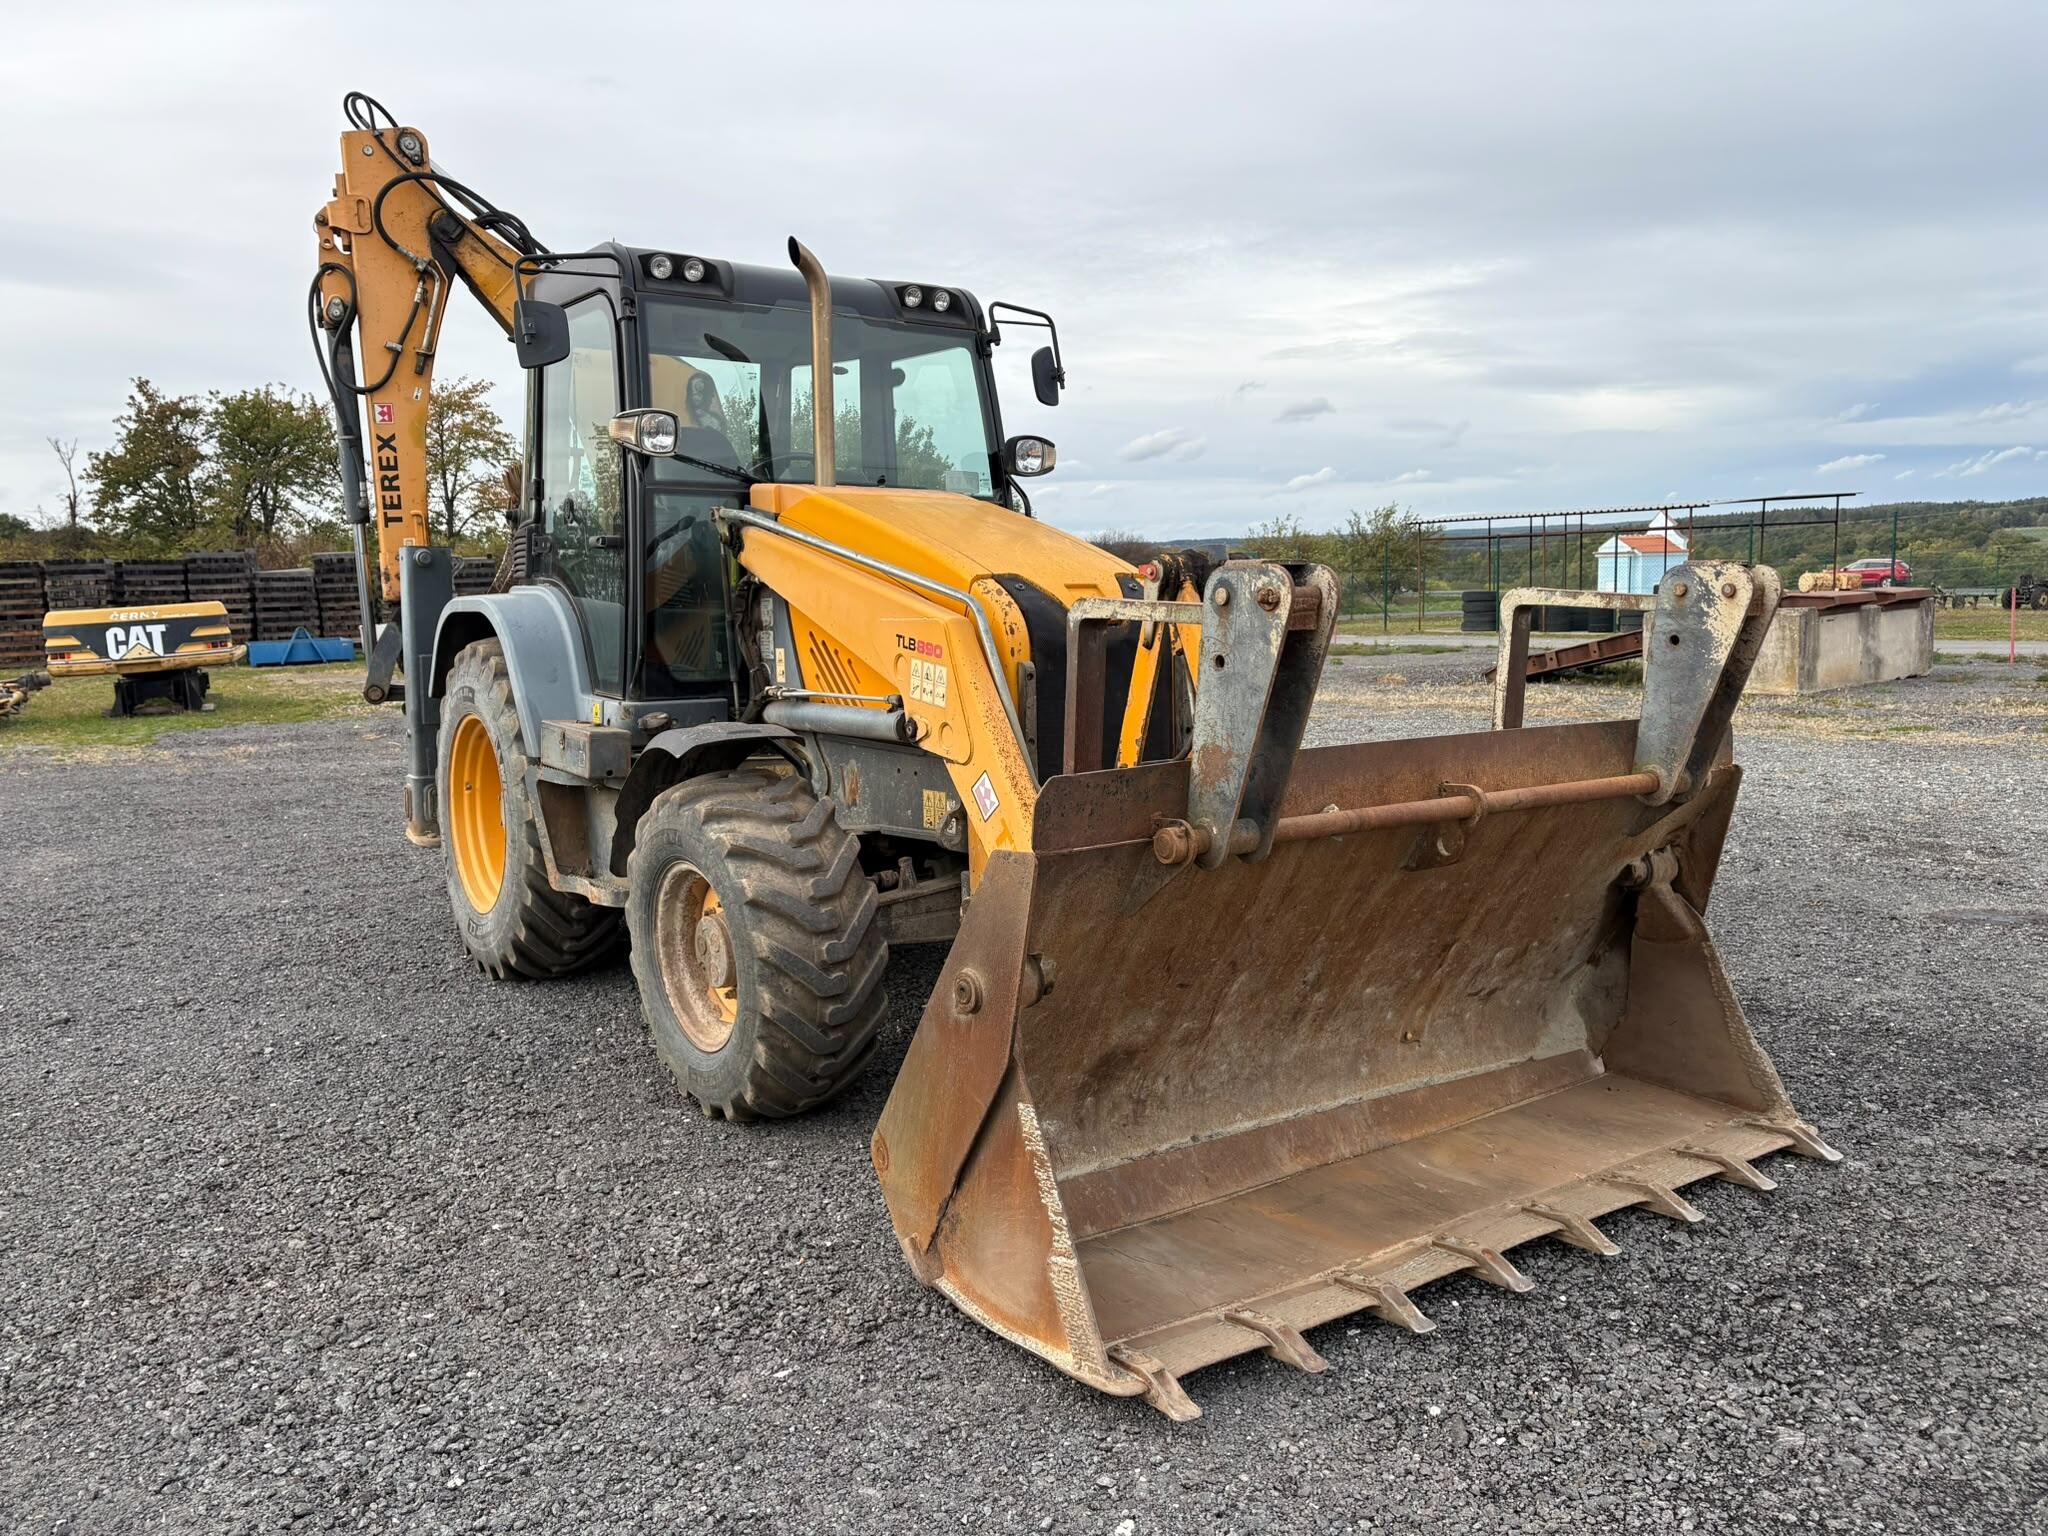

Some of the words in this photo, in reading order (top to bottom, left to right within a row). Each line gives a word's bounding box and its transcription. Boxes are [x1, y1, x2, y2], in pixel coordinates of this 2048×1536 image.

[376, 433, 403, 528] TEREX
[105, 624, 166, 660] CAT
[896, 633, 943, 658] TLB890
